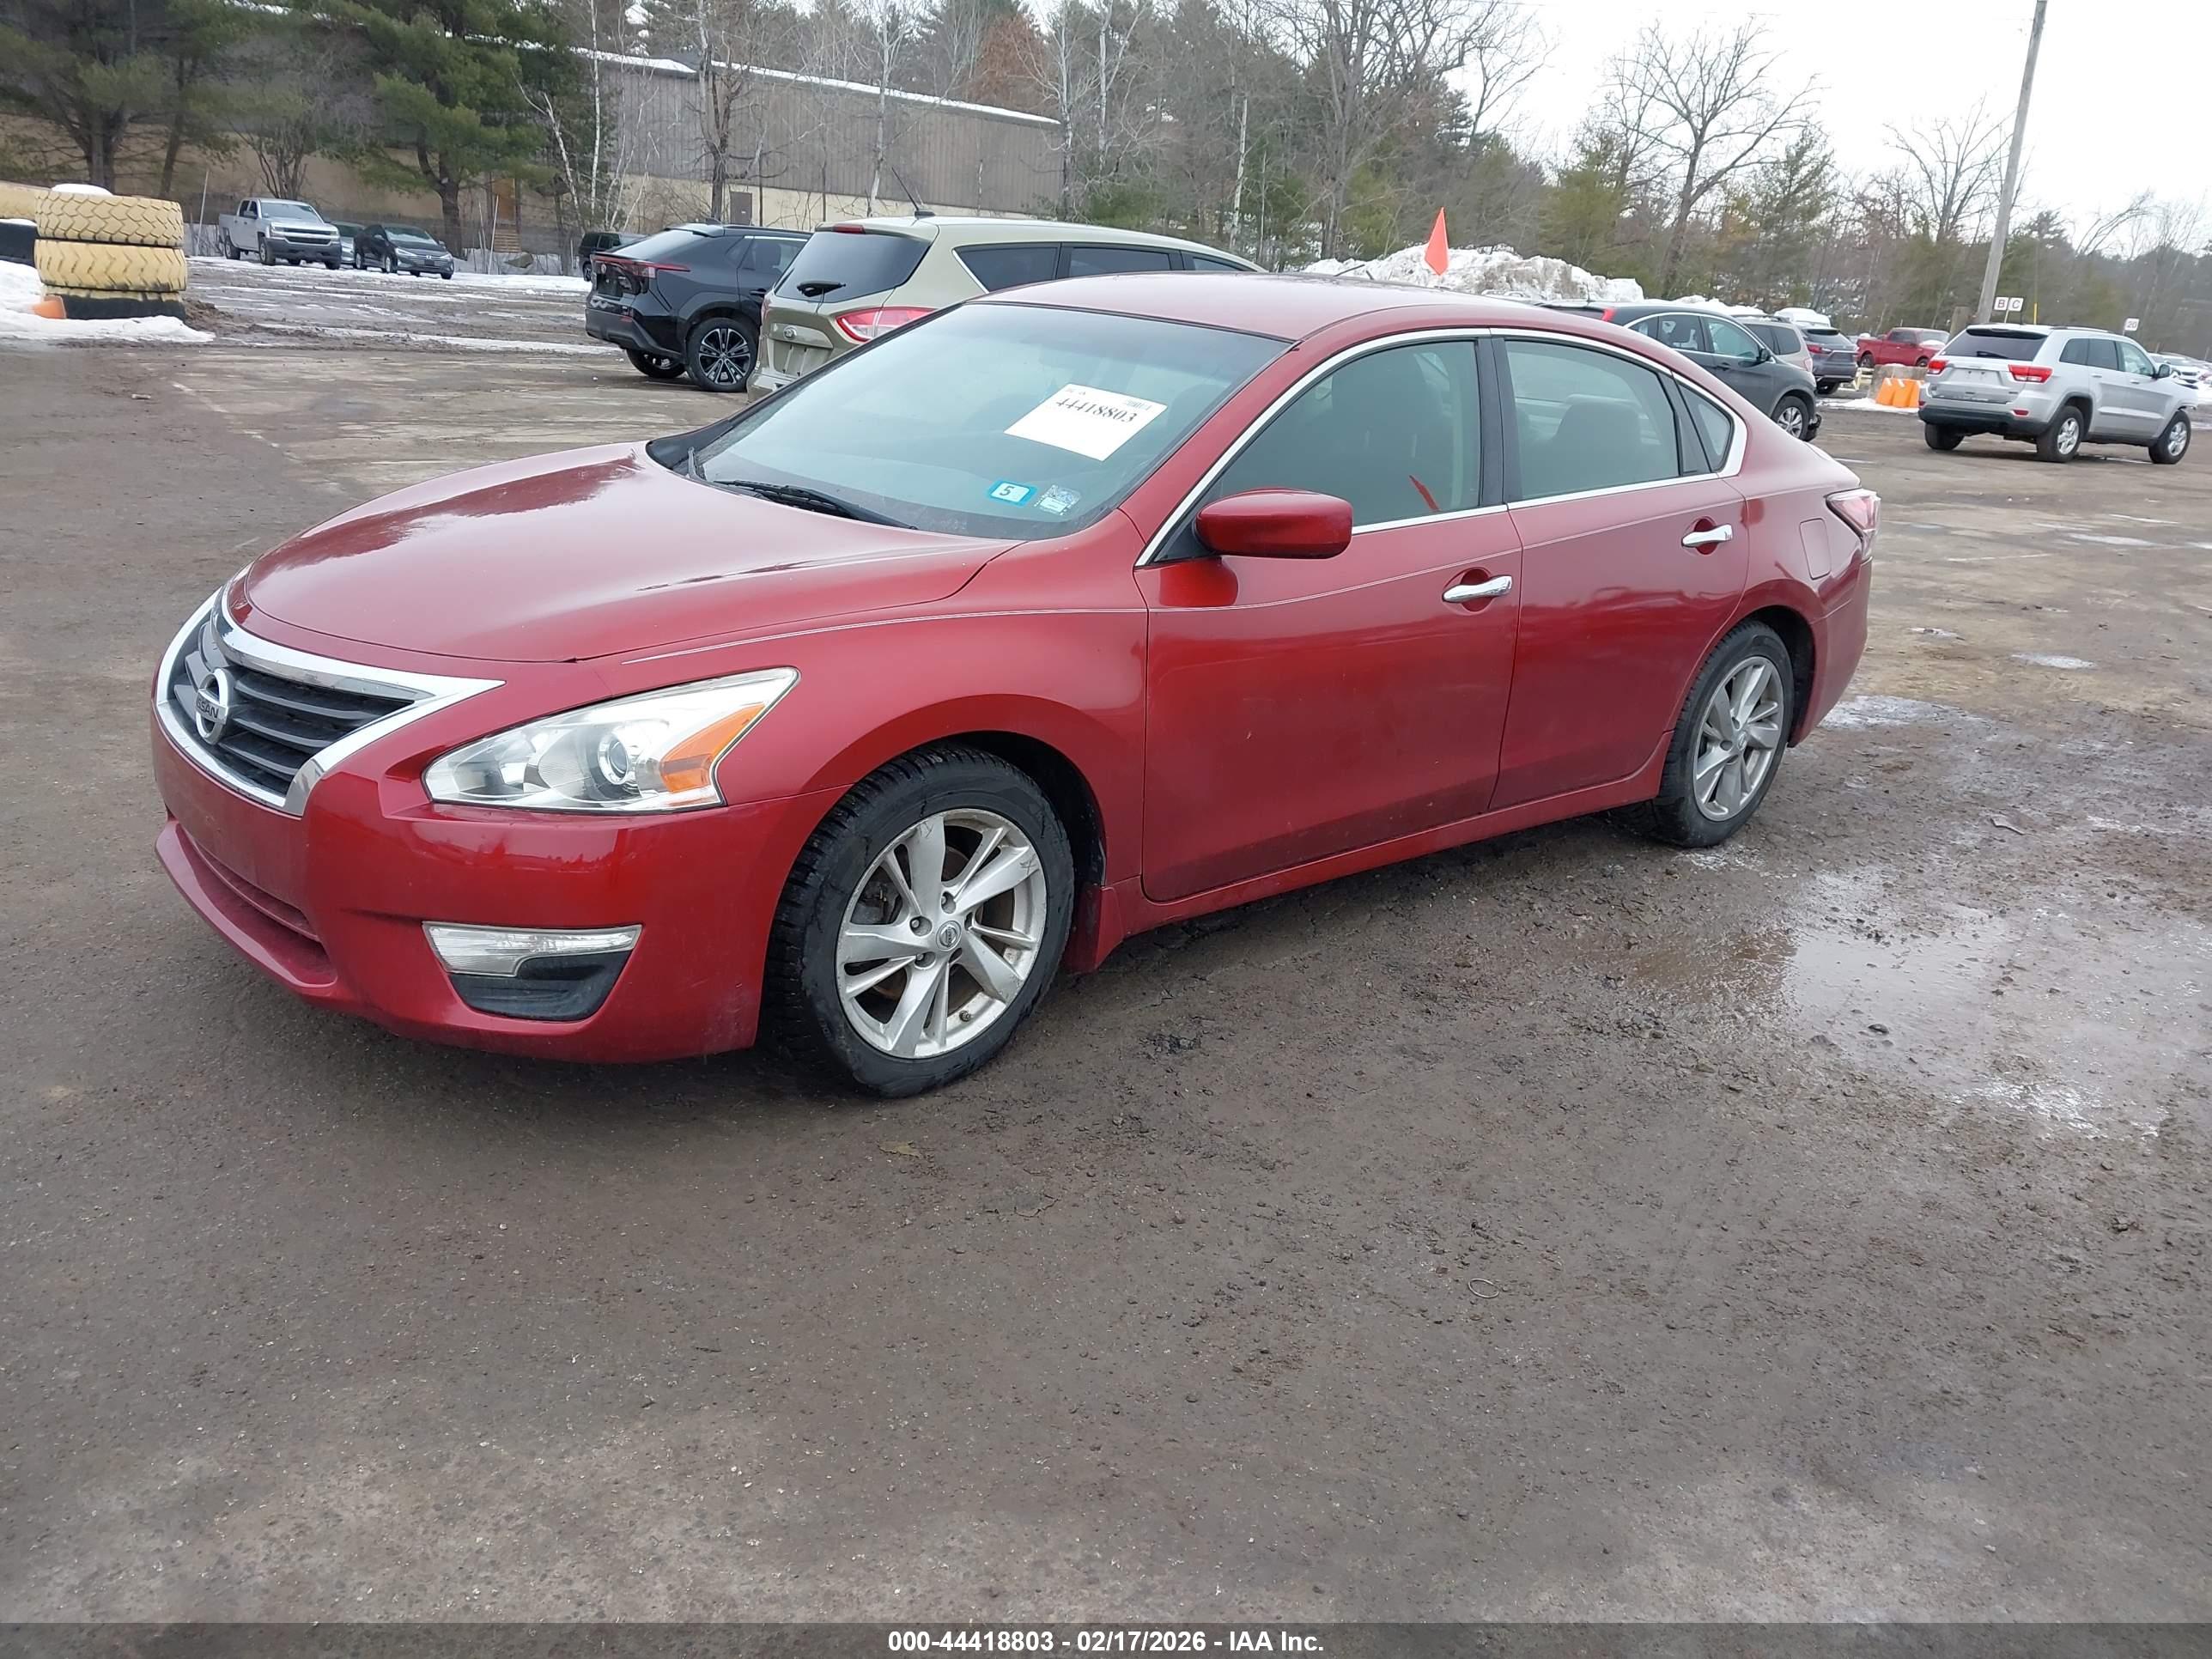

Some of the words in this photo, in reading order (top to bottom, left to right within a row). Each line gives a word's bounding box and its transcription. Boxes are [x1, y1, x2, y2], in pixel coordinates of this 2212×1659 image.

[1997, 299, 2006, 308] B
[2012, 300, 2021, 309] C
[1055, 397, 1138, 423] 44418803
[999, 485, 1015, 496] 5
[197, 697, 219, 719] SSAN
